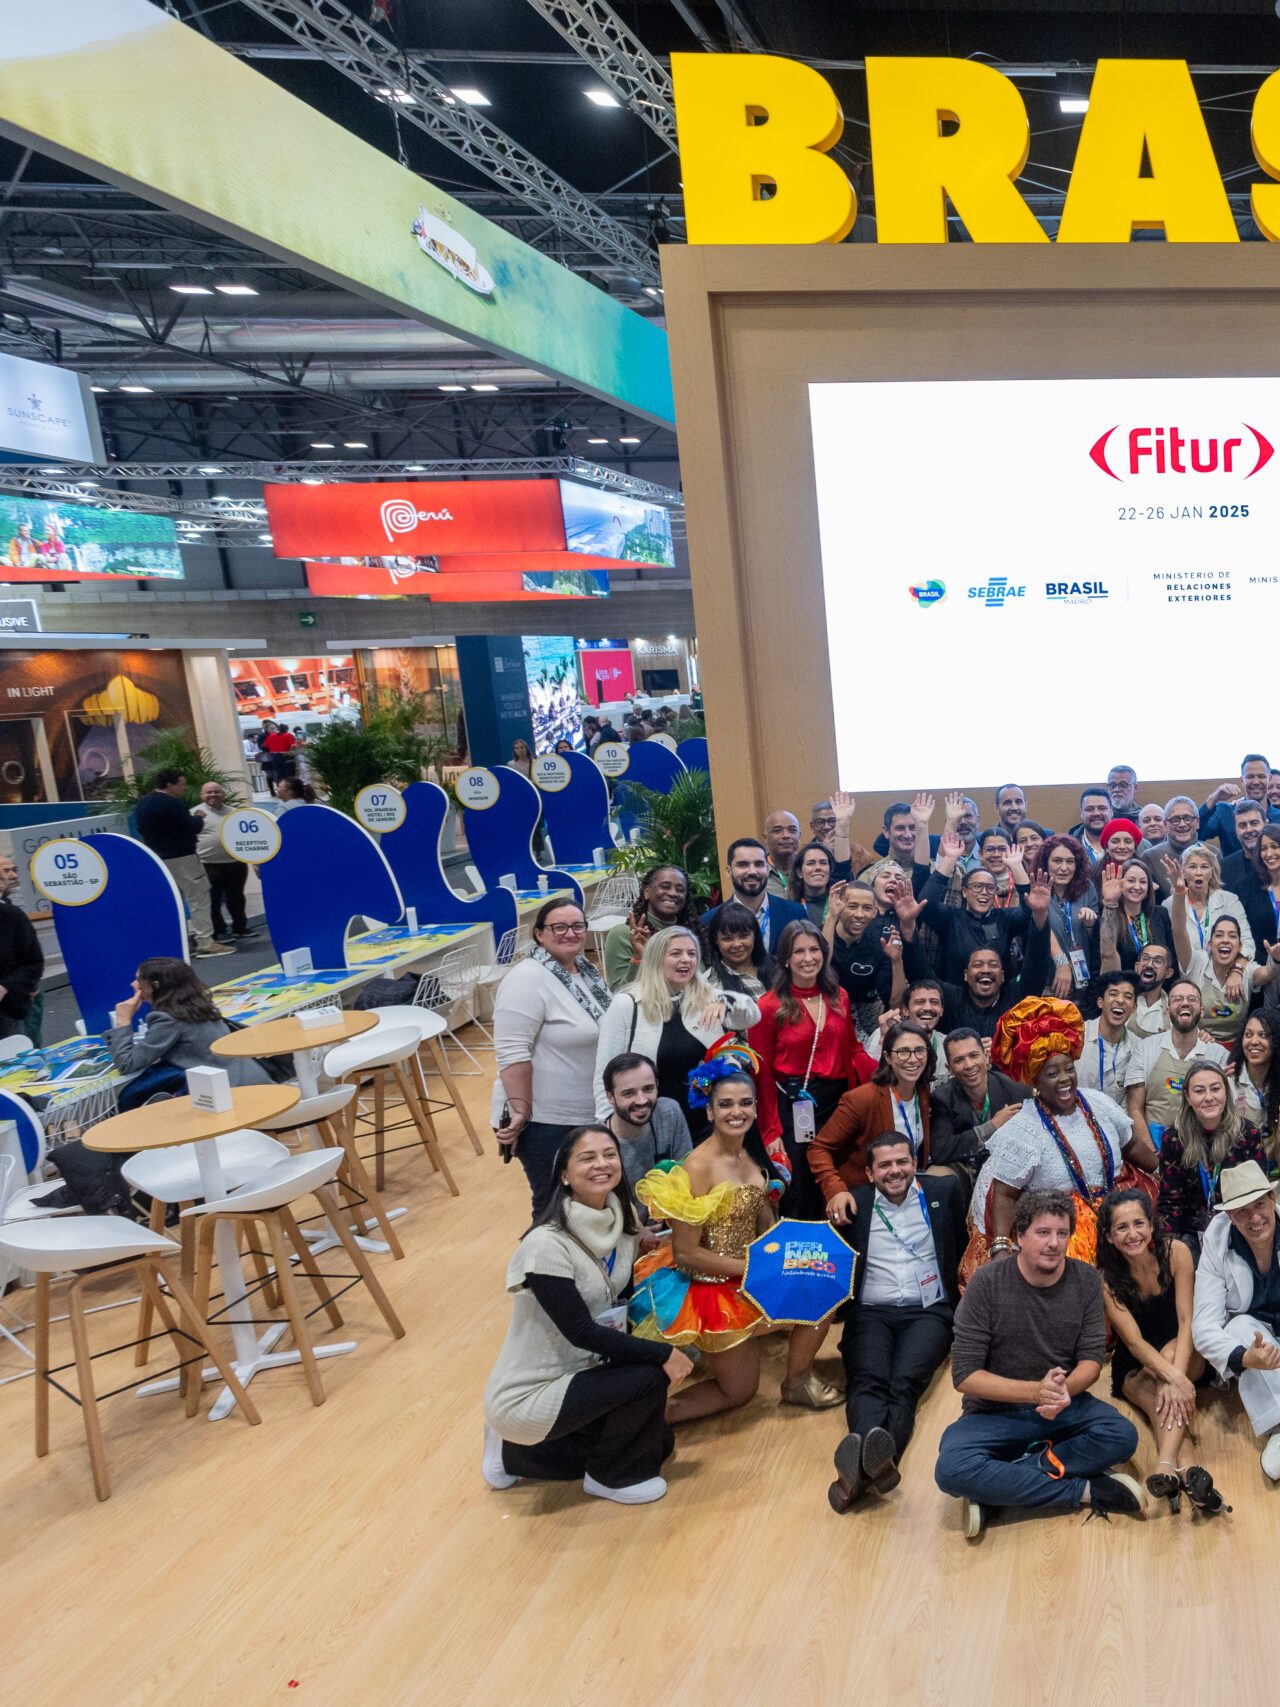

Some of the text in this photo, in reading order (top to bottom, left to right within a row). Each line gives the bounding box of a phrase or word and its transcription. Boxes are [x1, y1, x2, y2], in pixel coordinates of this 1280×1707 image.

[7, 407, 71, 428] SUNSCAPE
[1128, 426, 1243, 475] Fitur
[1118, 504, 1250, 521] 22-26 JAN 2025
[380, 498, 454, 543] Perú
[1153, 571, 1231, 580] MINISTERIO DE
[967, 585, 1027, 598] SEBRAE
[1045, 581, 1109, 596] BRASIL
[1166, 583, 1232, 591] RELACIONES
[918, 590, 941, 598] BRASIL
[1167, 594, 1232, 602] EXTERIORES
[637, 645, 680, 656] KARISMA
[7, 686, 55, 698] IN LIGHT
[606, 749, 617, 758] 10
[543, 761, 557, 771] 09
[469, 776, 484, 787] 08
[370, 794, 387, 806] 07
[239, 819, 260, 834] 06
[54, 853, 79, 870] 05
[44, 878, 84, 888] SEBASTIÃO
